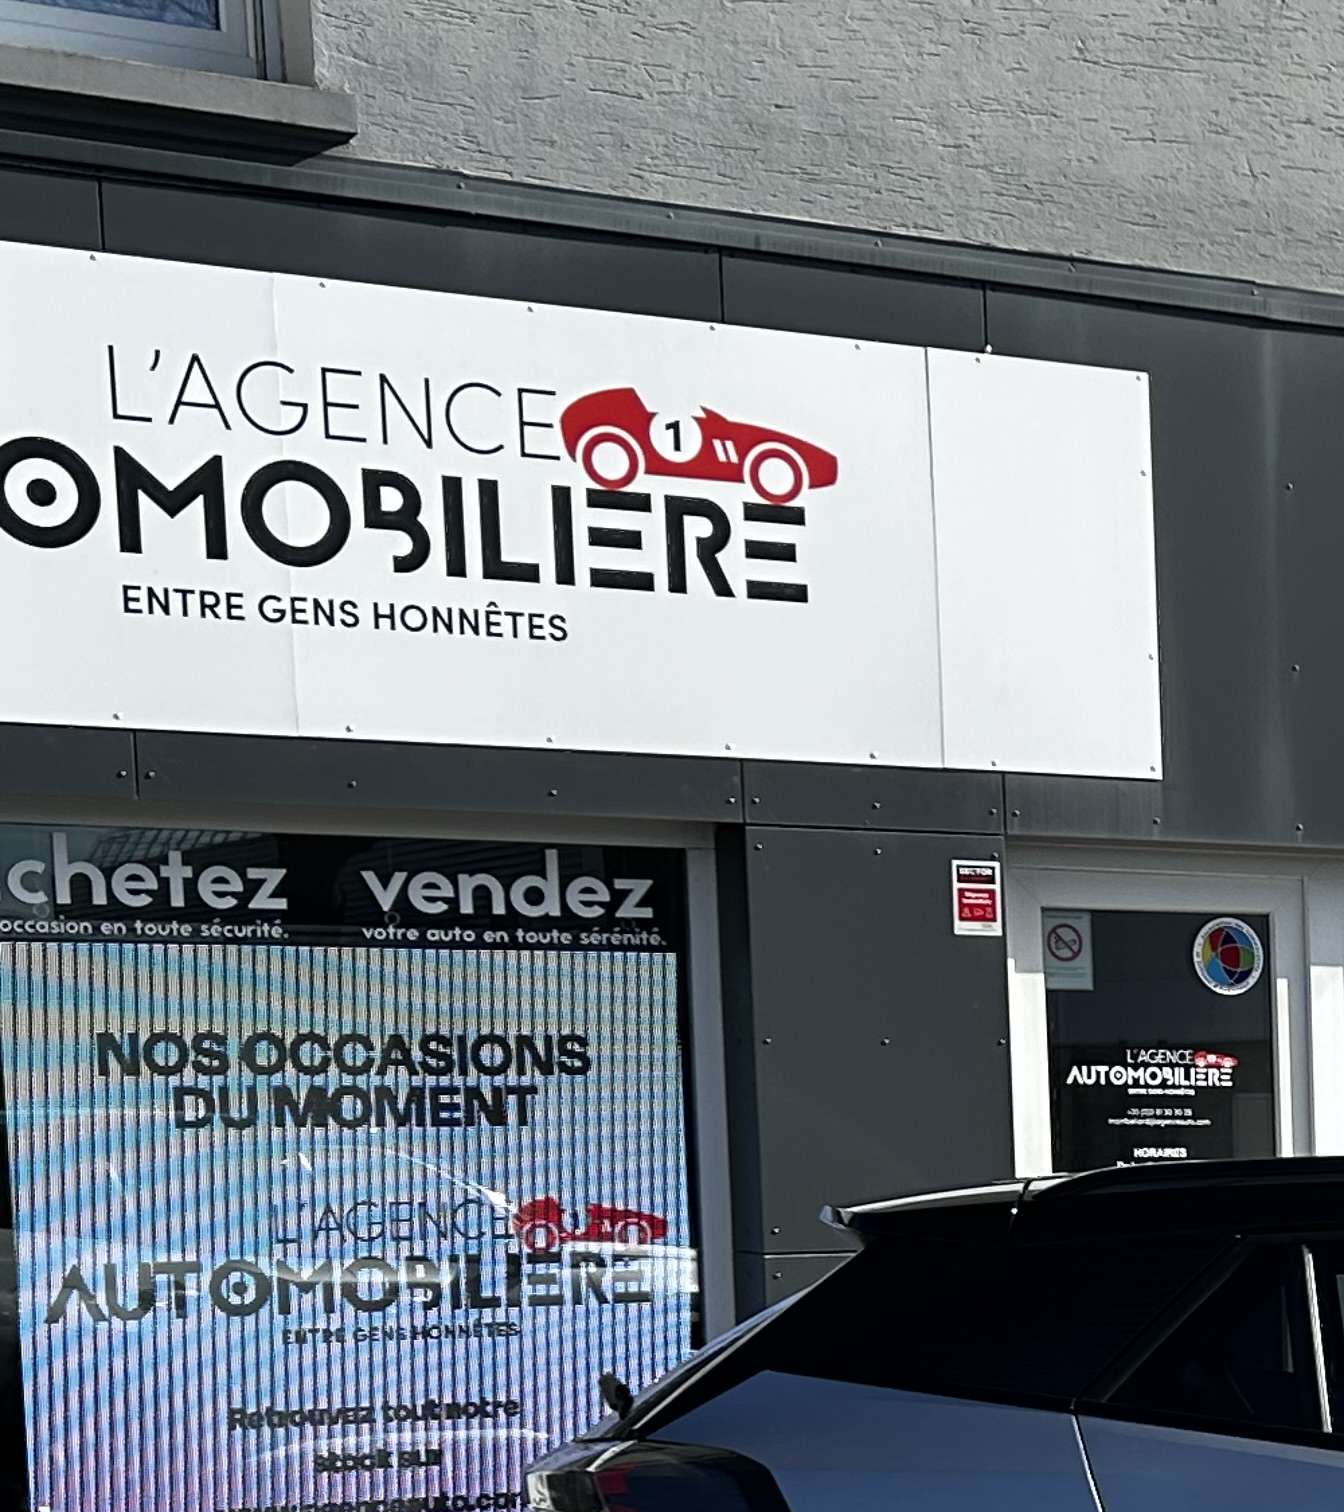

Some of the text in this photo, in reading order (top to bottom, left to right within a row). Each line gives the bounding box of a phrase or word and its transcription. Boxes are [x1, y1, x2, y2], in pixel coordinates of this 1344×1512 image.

[108, 343, 560, 461] L'AGENCE
[664, 419, 682, 452] 1
[122, 582, 568, 643] ENTRE GENS HONNÊTES
[360, 849, 654, 918] vendez
[0, 915, 288, 938] occasion en toute sécurité.
[361, 925, 667, 946] votre auto en toute sérénité.
[96, 1031, 591, 1077] NOS OCCASIONS
[173, 1085, 537, 1130] DU MOMENT
[228, 1405, 376, 1430] Retrouvez
[381, 1399, 442, 1423] tout
